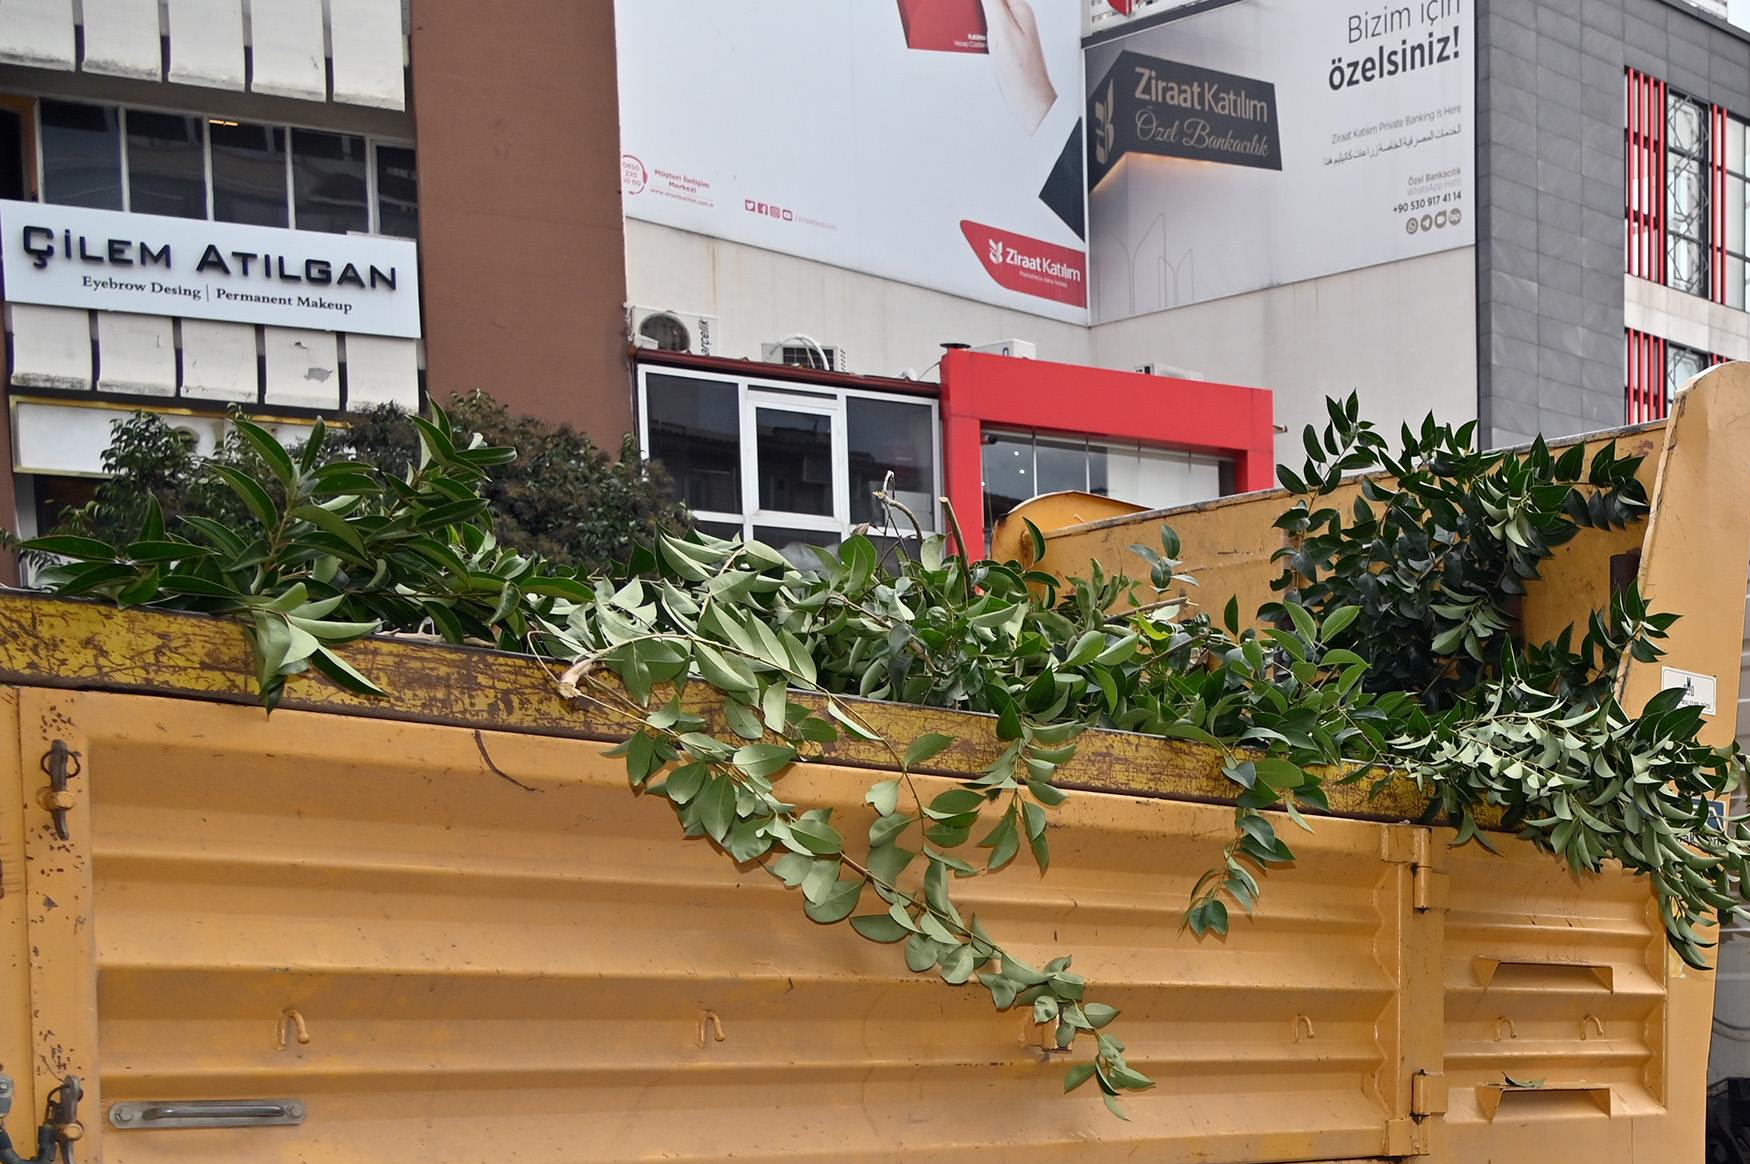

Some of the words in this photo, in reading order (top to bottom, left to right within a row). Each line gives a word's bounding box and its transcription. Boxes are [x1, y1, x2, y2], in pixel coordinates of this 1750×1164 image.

[1348, 6, 1411, 44] Bizim
[1328, 25, 1460, 91] özelsiniz!
[1134, 66, 1202, 110] Ziraat
[1204, 82, 1268, 123] Katılım
[1135, 105, 1180, 142] Özel
[1182, 117, 1269, 158] Bankacılık
[1379, 118, 1404, 134] Private
[1405, 111, 1435, 127] Banking
[1444, 104, 1462, 117] Here
[668, 181, 697, 193] Merkezi
[1393, 202, 1409, 213] +90
[1410, 199, 1426, 211] 530
[1427, 195, 1441, 207] 917
[1442, 193, 1451, 203] 41
[1452, 190, 1462, 201] 14
[23, 225, 172, 270] ÇİLEM
[196, 244, 397, 291] ATILGAN
[1005, 247, 1042, 273] Ziraat
[1042, 257, 1081, 282] Katılım
[82, 275, 146, 294] Eyebrow
[151, 281, 202, 300] Desing
[216, 288, 293, 306] Permanent
[297, 296, 353, 314] Makeup
